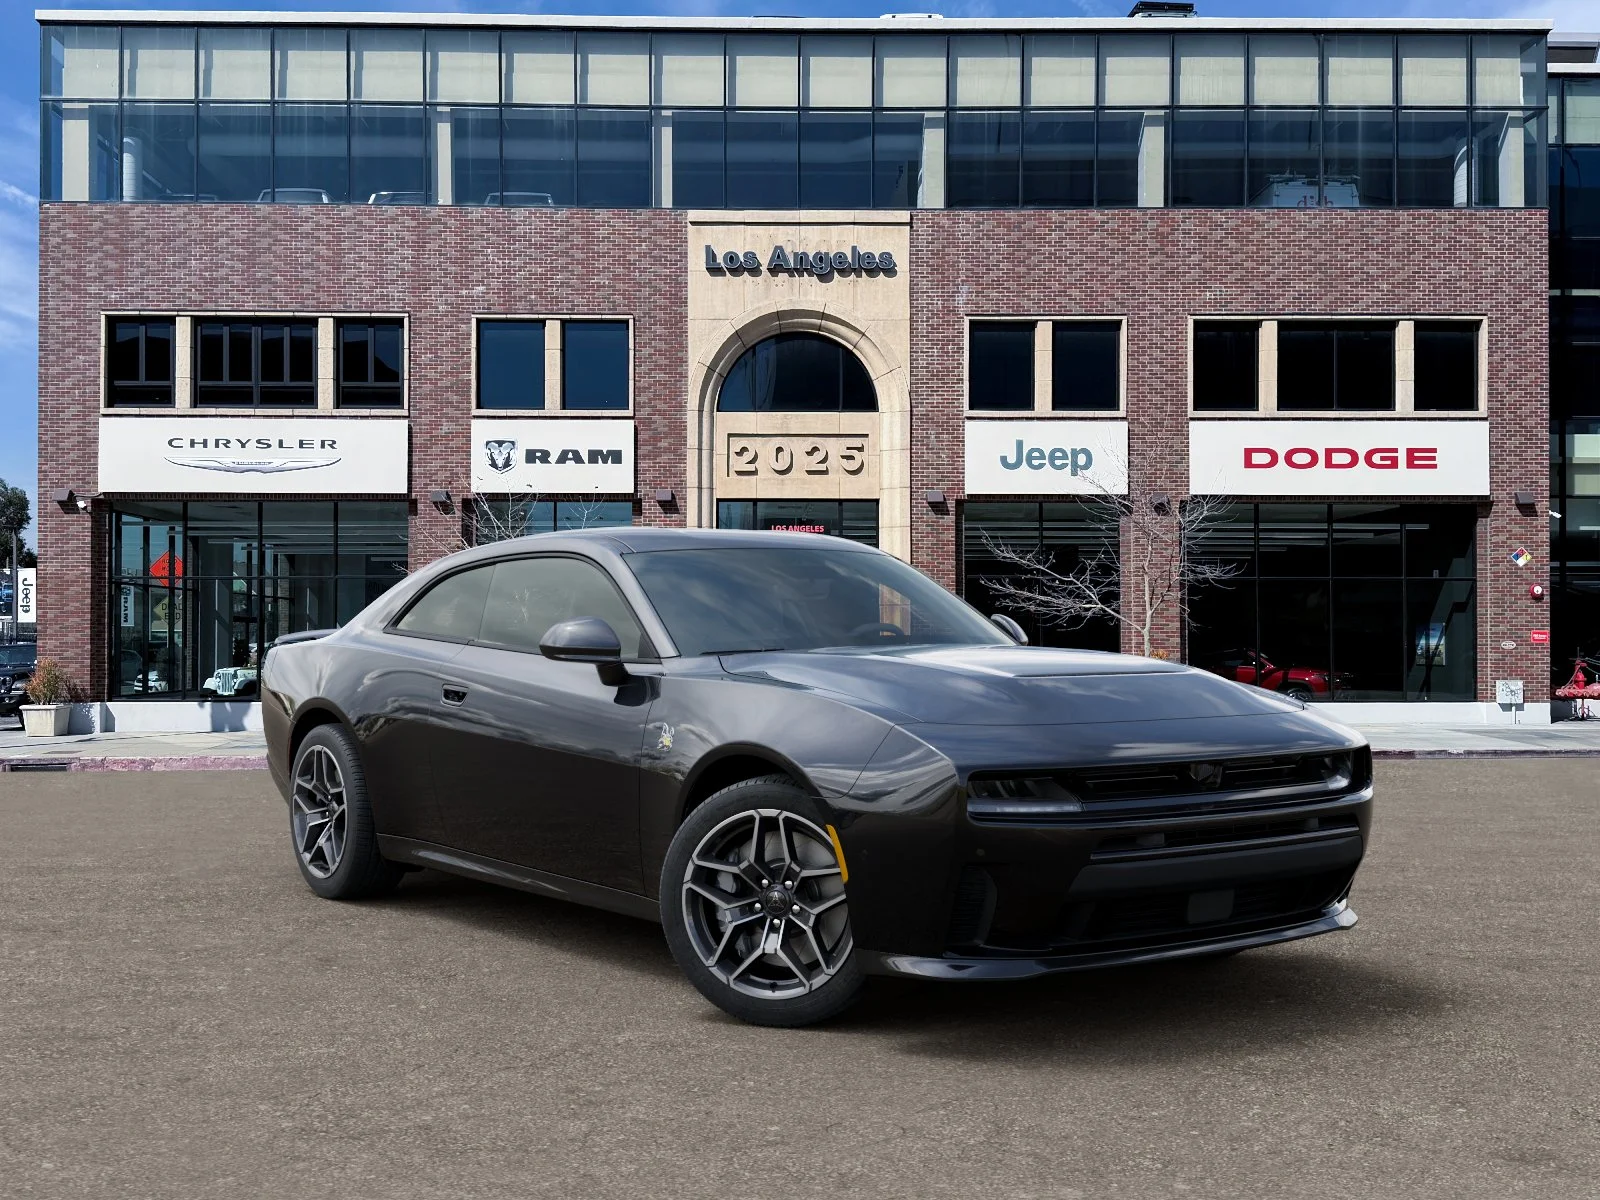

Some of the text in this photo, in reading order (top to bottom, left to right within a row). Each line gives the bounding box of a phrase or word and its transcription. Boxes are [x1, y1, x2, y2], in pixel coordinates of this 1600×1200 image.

[704, 244, 897, 277] Los Angeles
[167, 437, 338, 450] CHRYSLER
[525, 448, 623, 465] RAM
[733, 440, 866, 476] 2025
[999, 440, 1094, 476] Jeep
[1243, 447, 1438, 470] DODGE
[788, 525, 825, 533] ANGELES
[20, 577, 33, 613] Jeep
